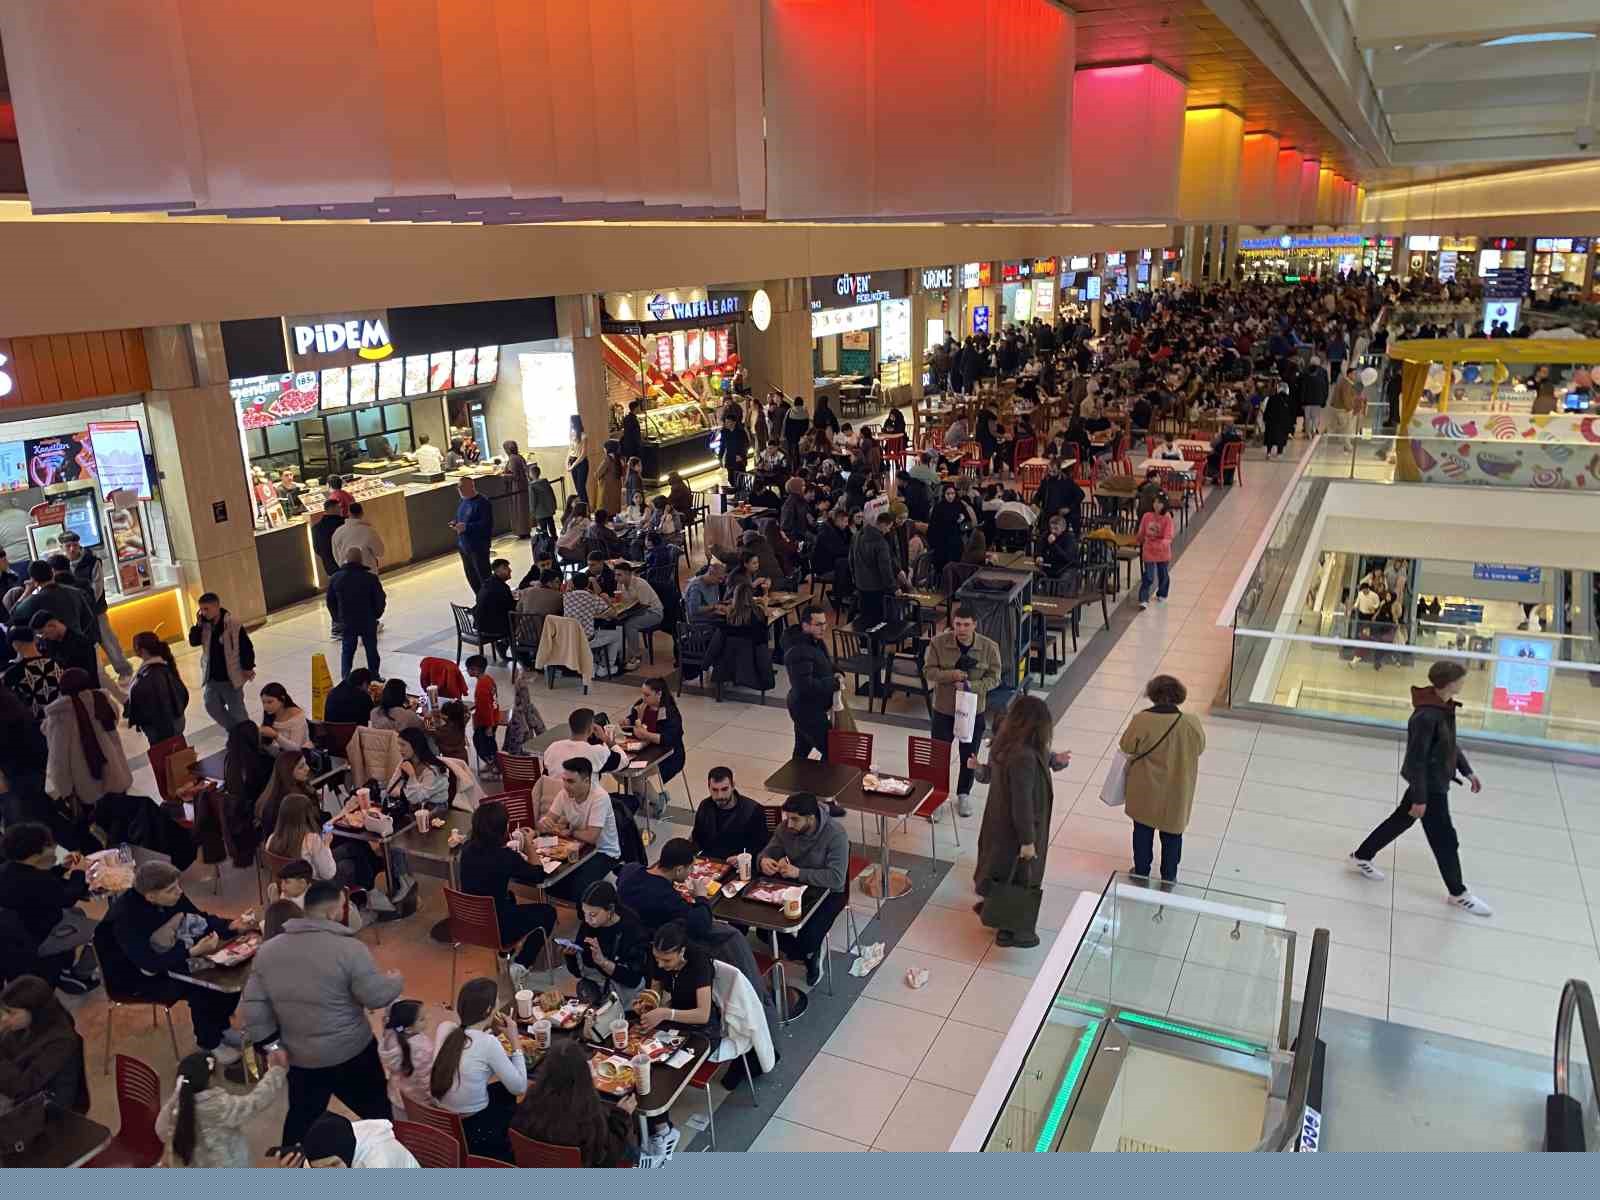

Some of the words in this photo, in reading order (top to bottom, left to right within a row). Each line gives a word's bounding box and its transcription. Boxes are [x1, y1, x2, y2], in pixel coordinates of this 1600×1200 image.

[837, 272, 869, 296] GÜVEN
[922, 268, 953, 289] ÜRÜMLE
[674, 300, 719, 319] WAFFLE
[720, 297, 739, 313] ART
